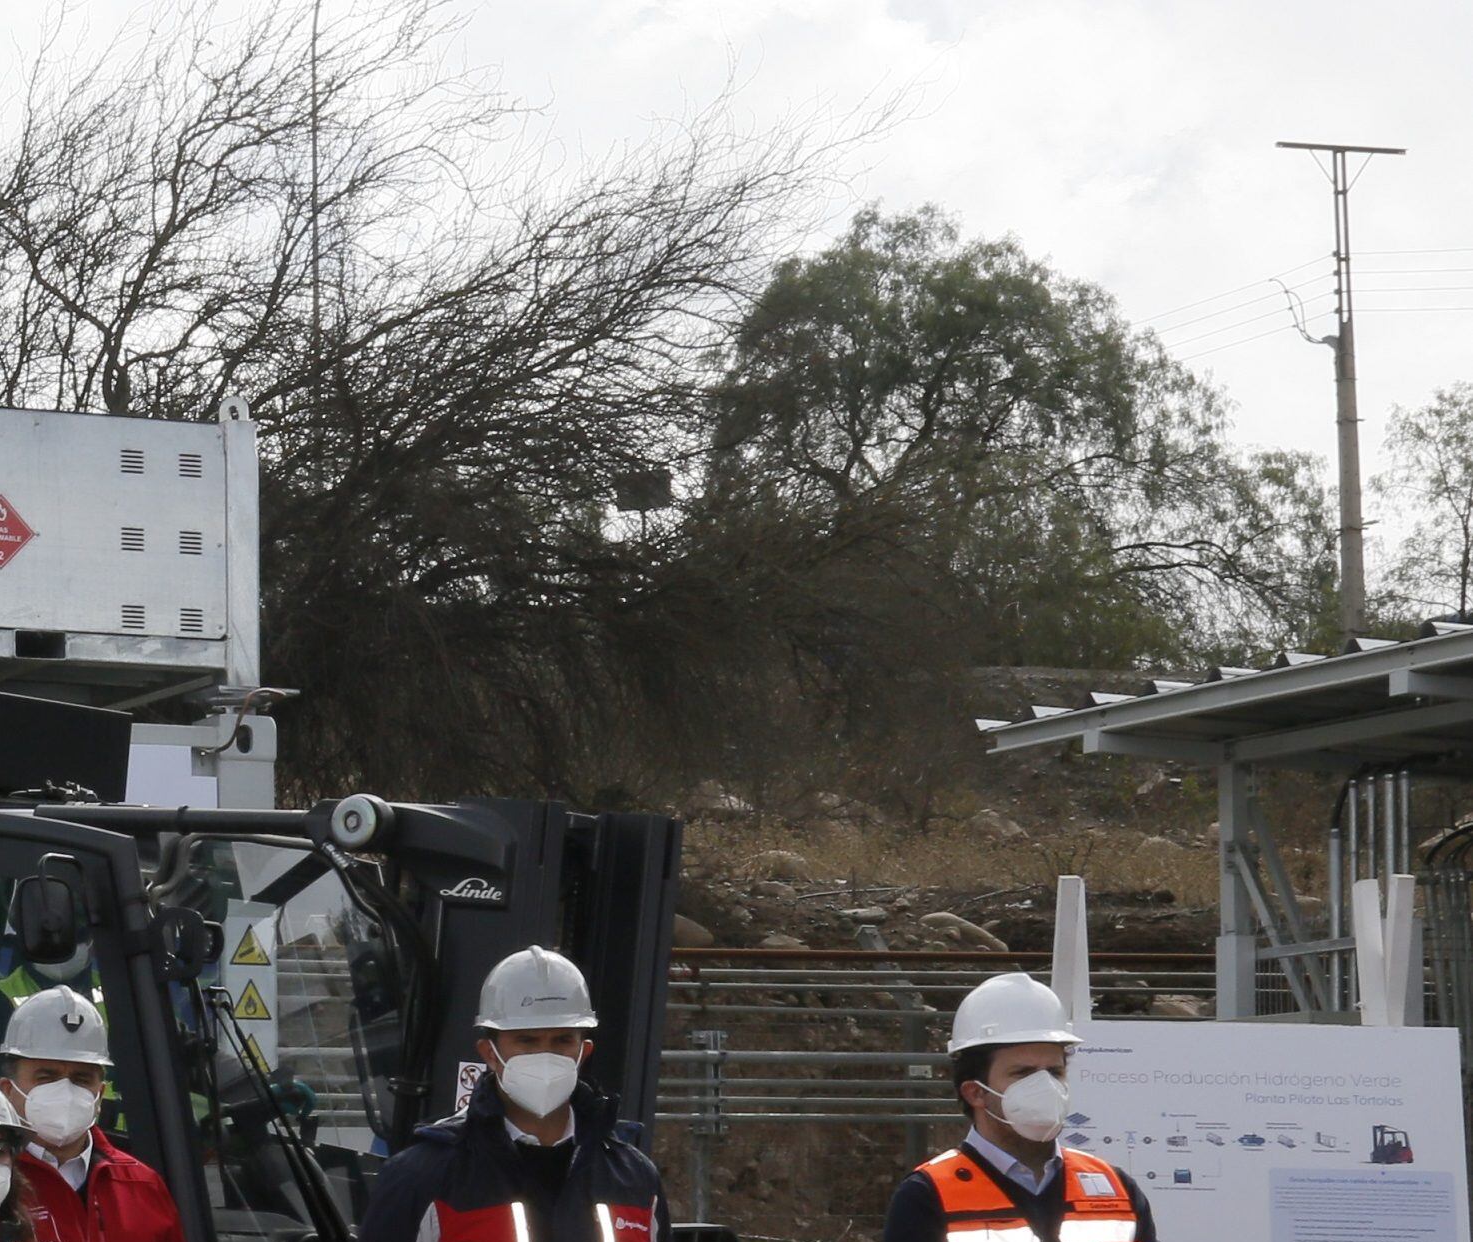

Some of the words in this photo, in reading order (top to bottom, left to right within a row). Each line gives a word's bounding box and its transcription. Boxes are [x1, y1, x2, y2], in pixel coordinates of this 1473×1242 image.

[439, 877, 503, 900] Linde
[1080, 1069, 1149, 1084] Proceso
[1154, 1070, 1250, 1085] Producción
[1256, 1072, 1346, 1089] Hidrógeno
[1350, 1073, 1402, 1088] Verde
[1245, 1092, 1286, 1104] Planta
[1289, 1093, 1325, 1105] Piloto
[1327, 1094, 1350, 1106] Las
